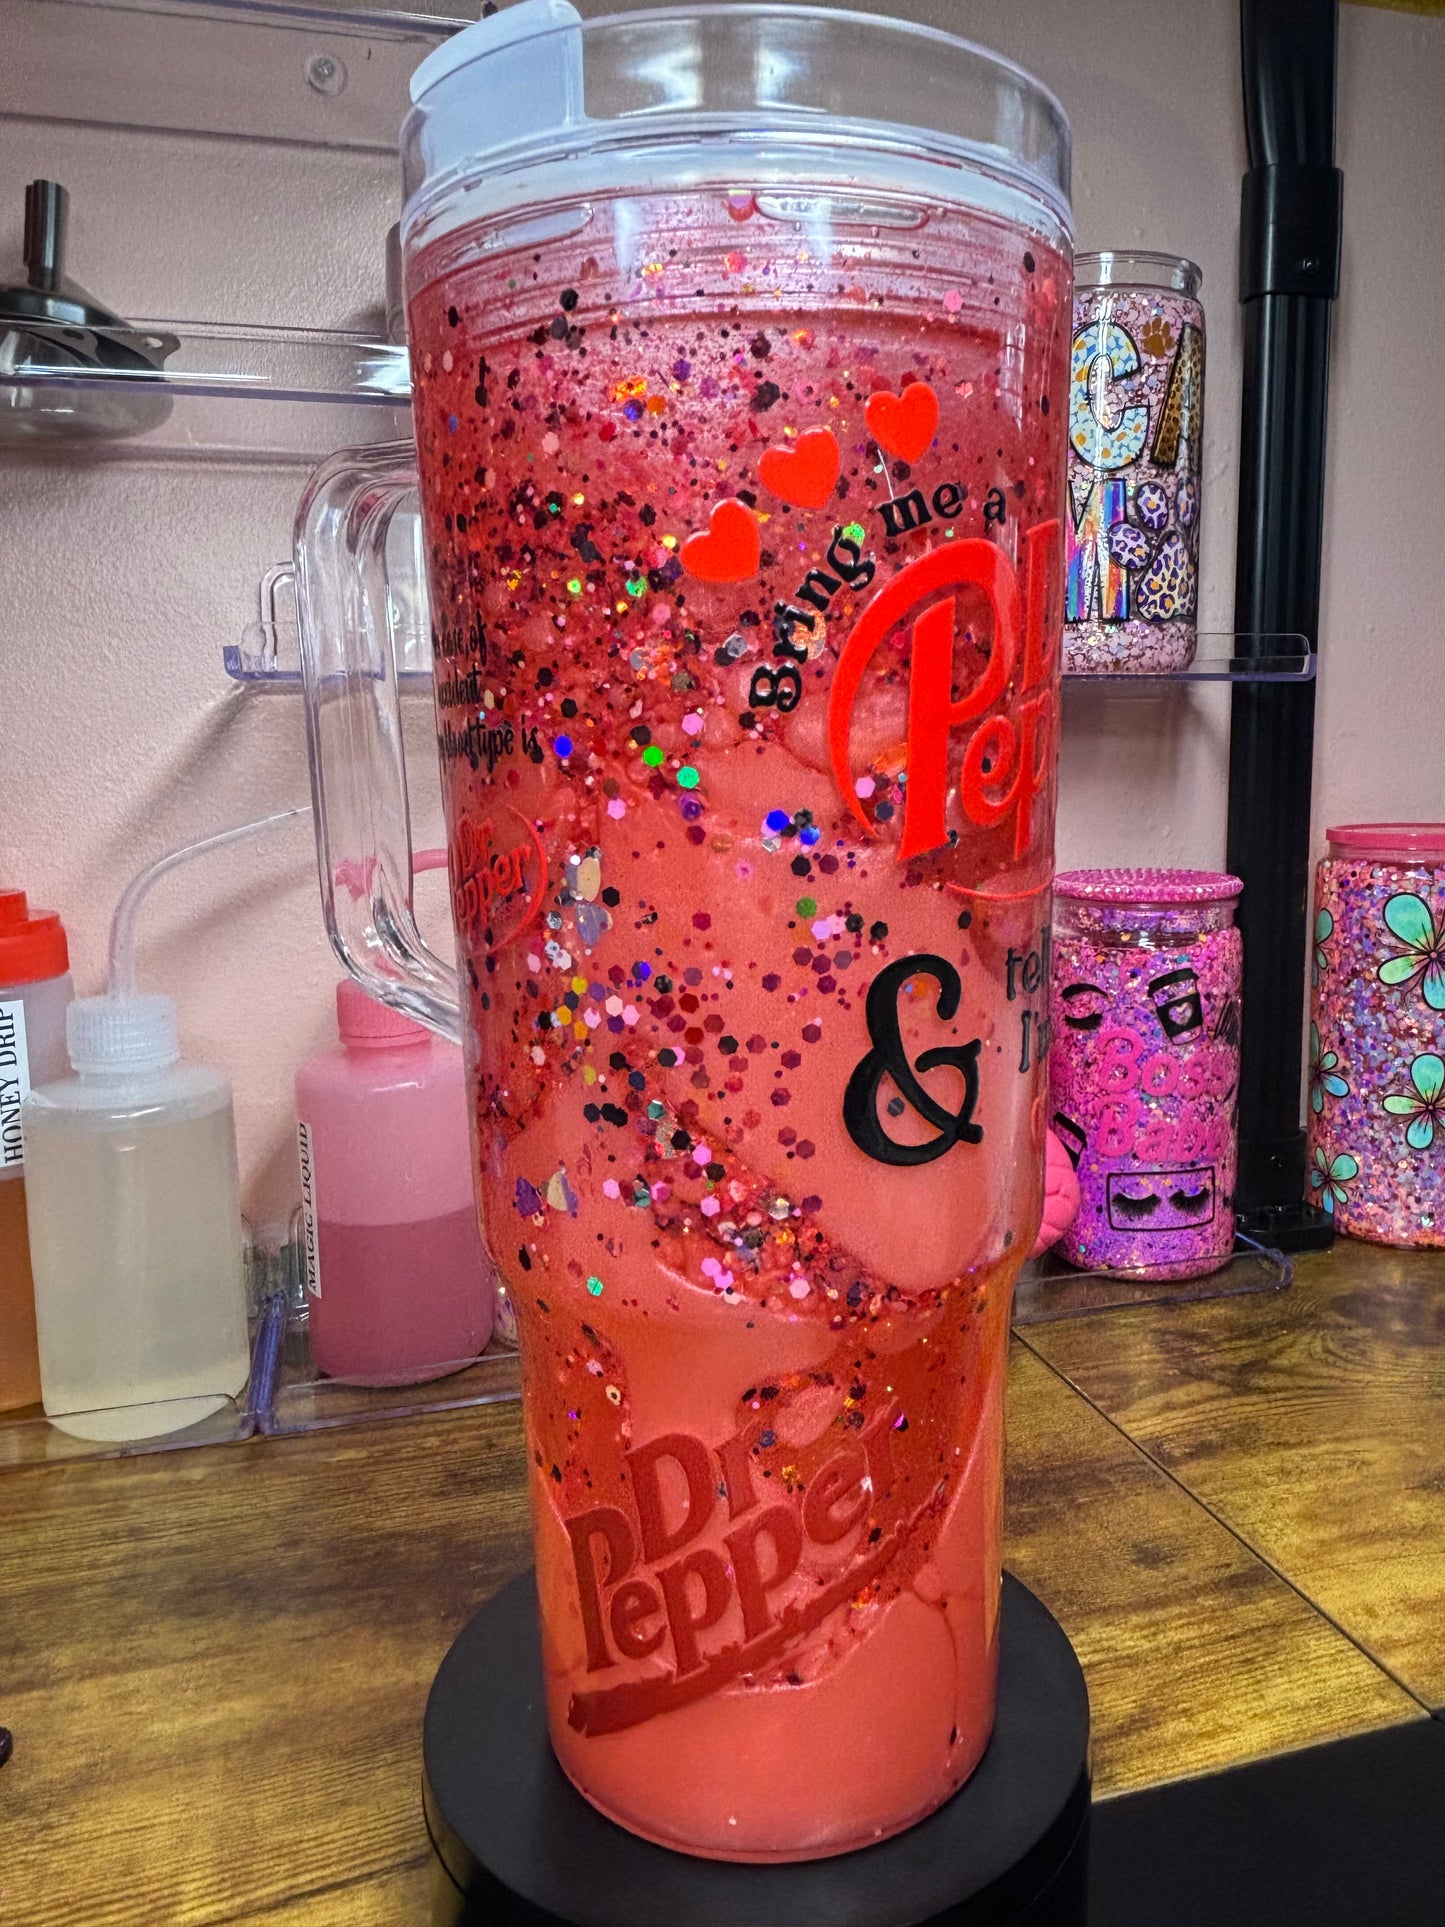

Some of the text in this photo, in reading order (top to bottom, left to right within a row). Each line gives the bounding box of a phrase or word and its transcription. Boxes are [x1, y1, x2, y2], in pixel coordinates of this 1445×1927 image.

[748, 481, 1008, 713] Bring me a
[520, 713, 541, 758] is
[0, 1007, 25, 1164] HONEY DRIP
[842, 953, 985, 1166] &
[299, 1122, 317, 1292] MAGIC LIQUID
[564, 1397, 900, 1684] Pepper
[624, 1417, 764, 1566] Dr
